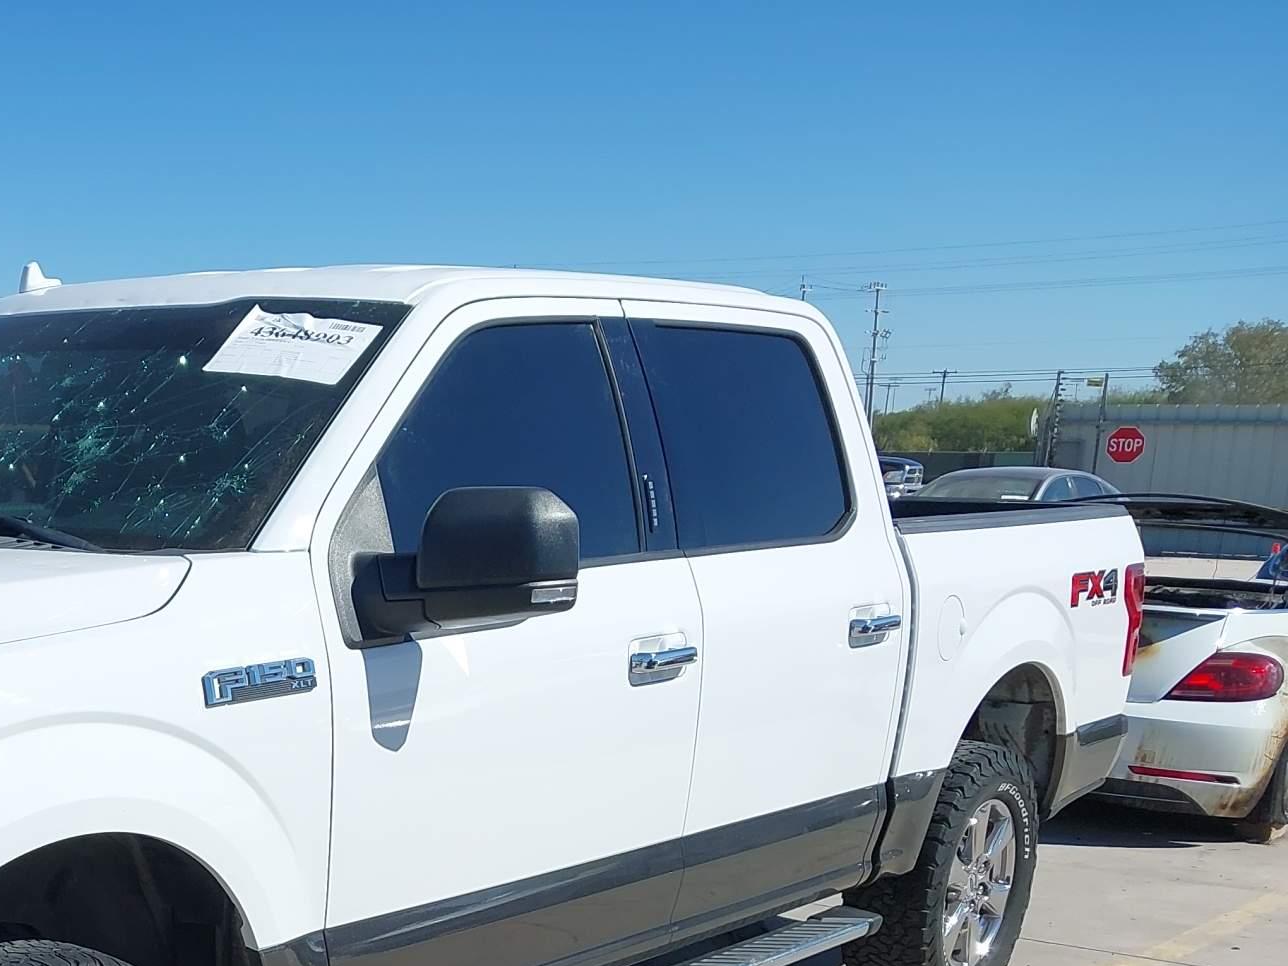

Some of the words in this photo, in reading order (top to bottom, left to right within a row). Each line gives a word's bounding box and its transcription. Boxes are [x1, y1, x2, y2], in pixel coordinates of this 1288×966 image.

[1108, 438, 1143, 453] STOP
[1070, 568, 1119, 608] FX4
[290, 679, 314, 690] XLT
[997, 782, 1031, 860] BFGoodrich
